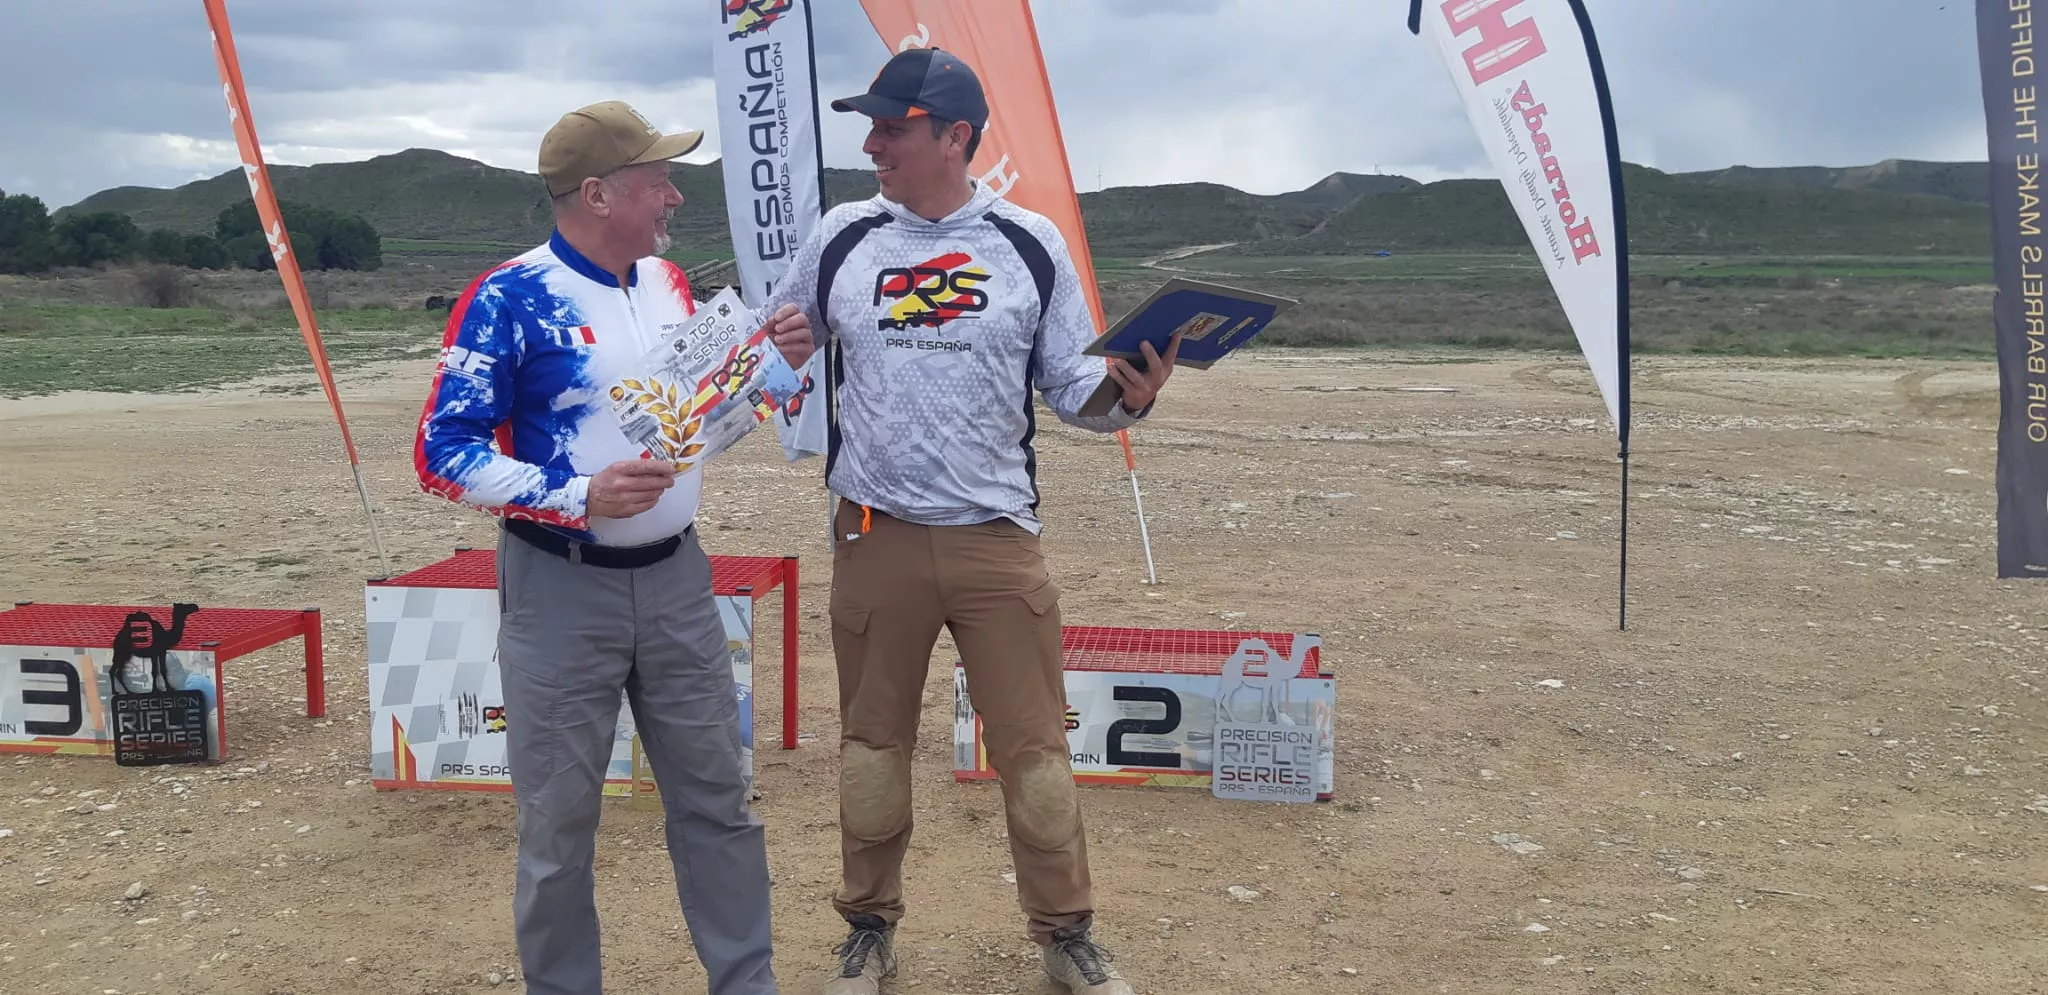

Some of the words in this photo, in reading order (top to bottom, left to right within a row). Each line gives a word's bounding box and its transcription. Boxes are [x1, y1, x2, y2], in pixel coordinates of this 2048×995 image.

[771, 42, 789, 158] COMPETICIÓN
[738, 43, 786, 261] ESPAÑA
[780, 162, 795, 225] SOMOS
[873, 267, 993, 312] PRS
[689, 316, 716, 340] TOP
[693, 324, 737, 363] SENIOR
[886, 338, 914, 349] PRS
[917, 340, 972, 352] ESPAÑA
[712, 346, 759, 394] PRS
[129, 621, 153, 648] 3
[1242, 649, 1268, 677] 2
[20, 659, 83, 736] 3
[117, 696, 199, 711] PRECISION
[119, 708, 201, 732] RIFLE
[1106, 686, 1181, 768] 2
[120, 730, 203, 750] SERIES
[1220, 728, 1312, 744] PRECISION
[121, 752, 145, 760] PRS
[1220, 742, 1312, 766] RIFLE
[441, 763, 475, 775] PRS
[1220, 765, 1312, 785] SERIES
[1219, 783, 1245, 793] PRS
[1258, 785, 1311, 797] ESPAÑA
